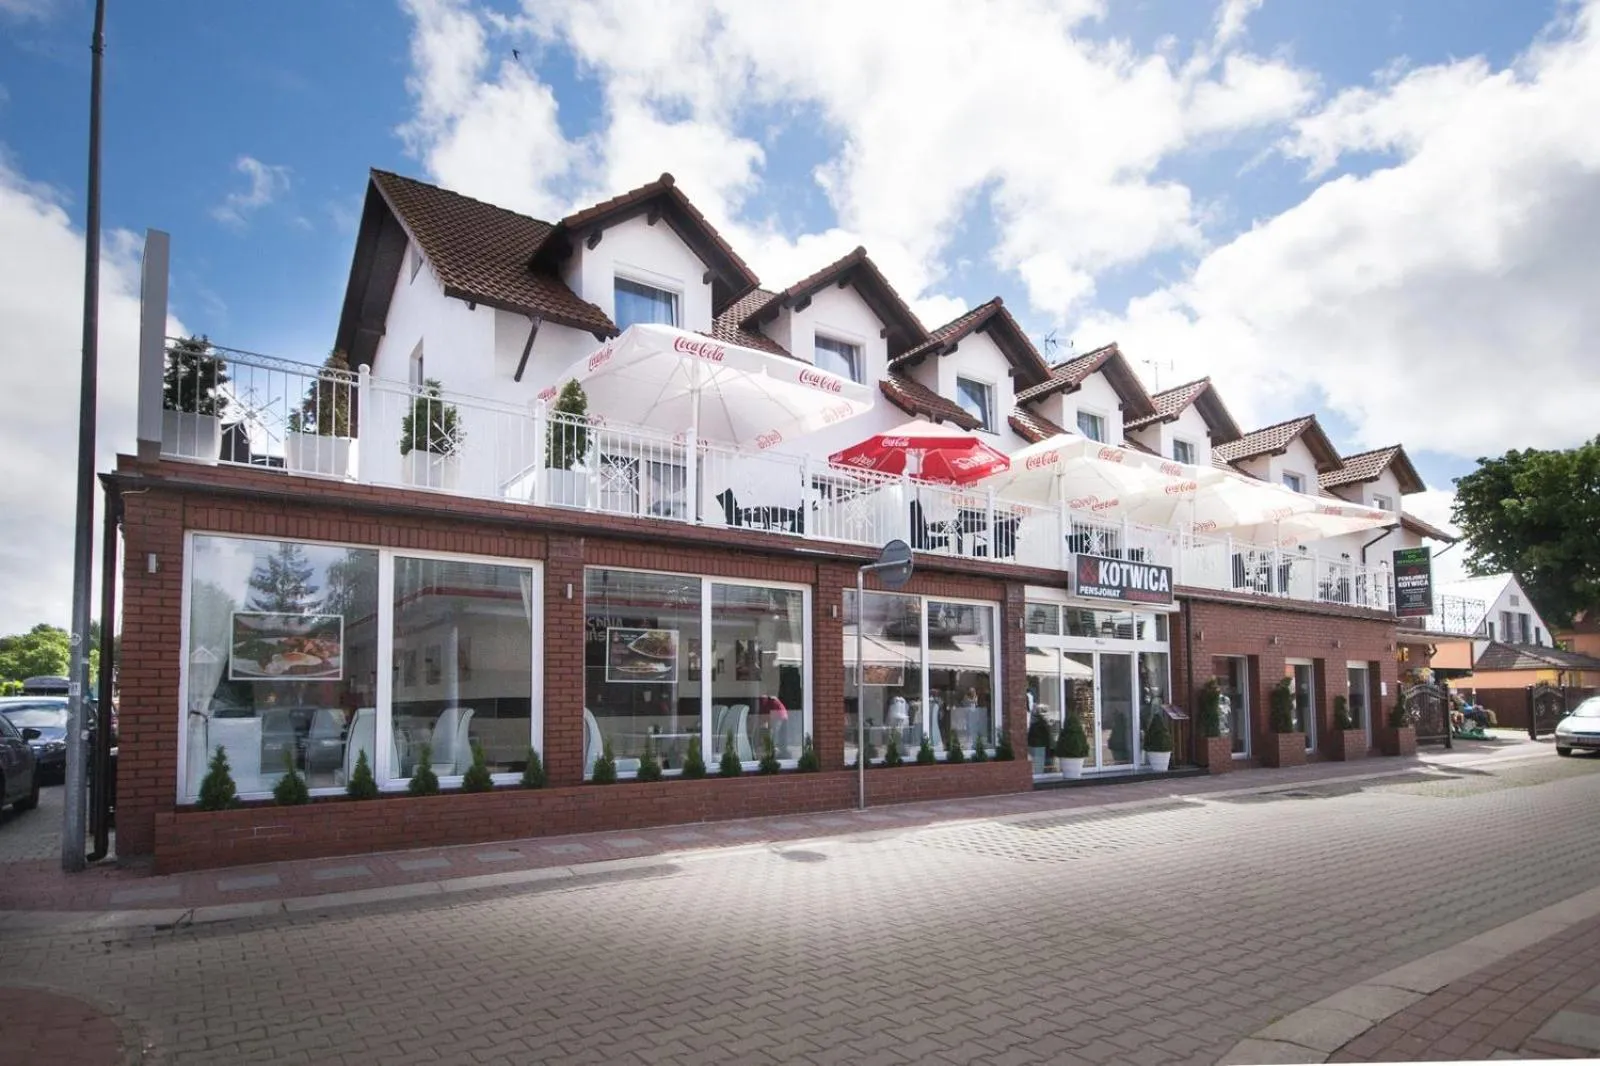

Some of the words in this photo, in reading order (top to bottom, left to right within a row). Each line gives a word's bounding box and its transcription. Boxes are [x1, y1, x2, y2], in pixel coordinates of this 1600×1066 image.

[1098, 560, 1169, 592] KOTWICA
[1398, 580, 1429, 588] KOTWICA
[1080, 586, 1121, 597] PENSJONAT
